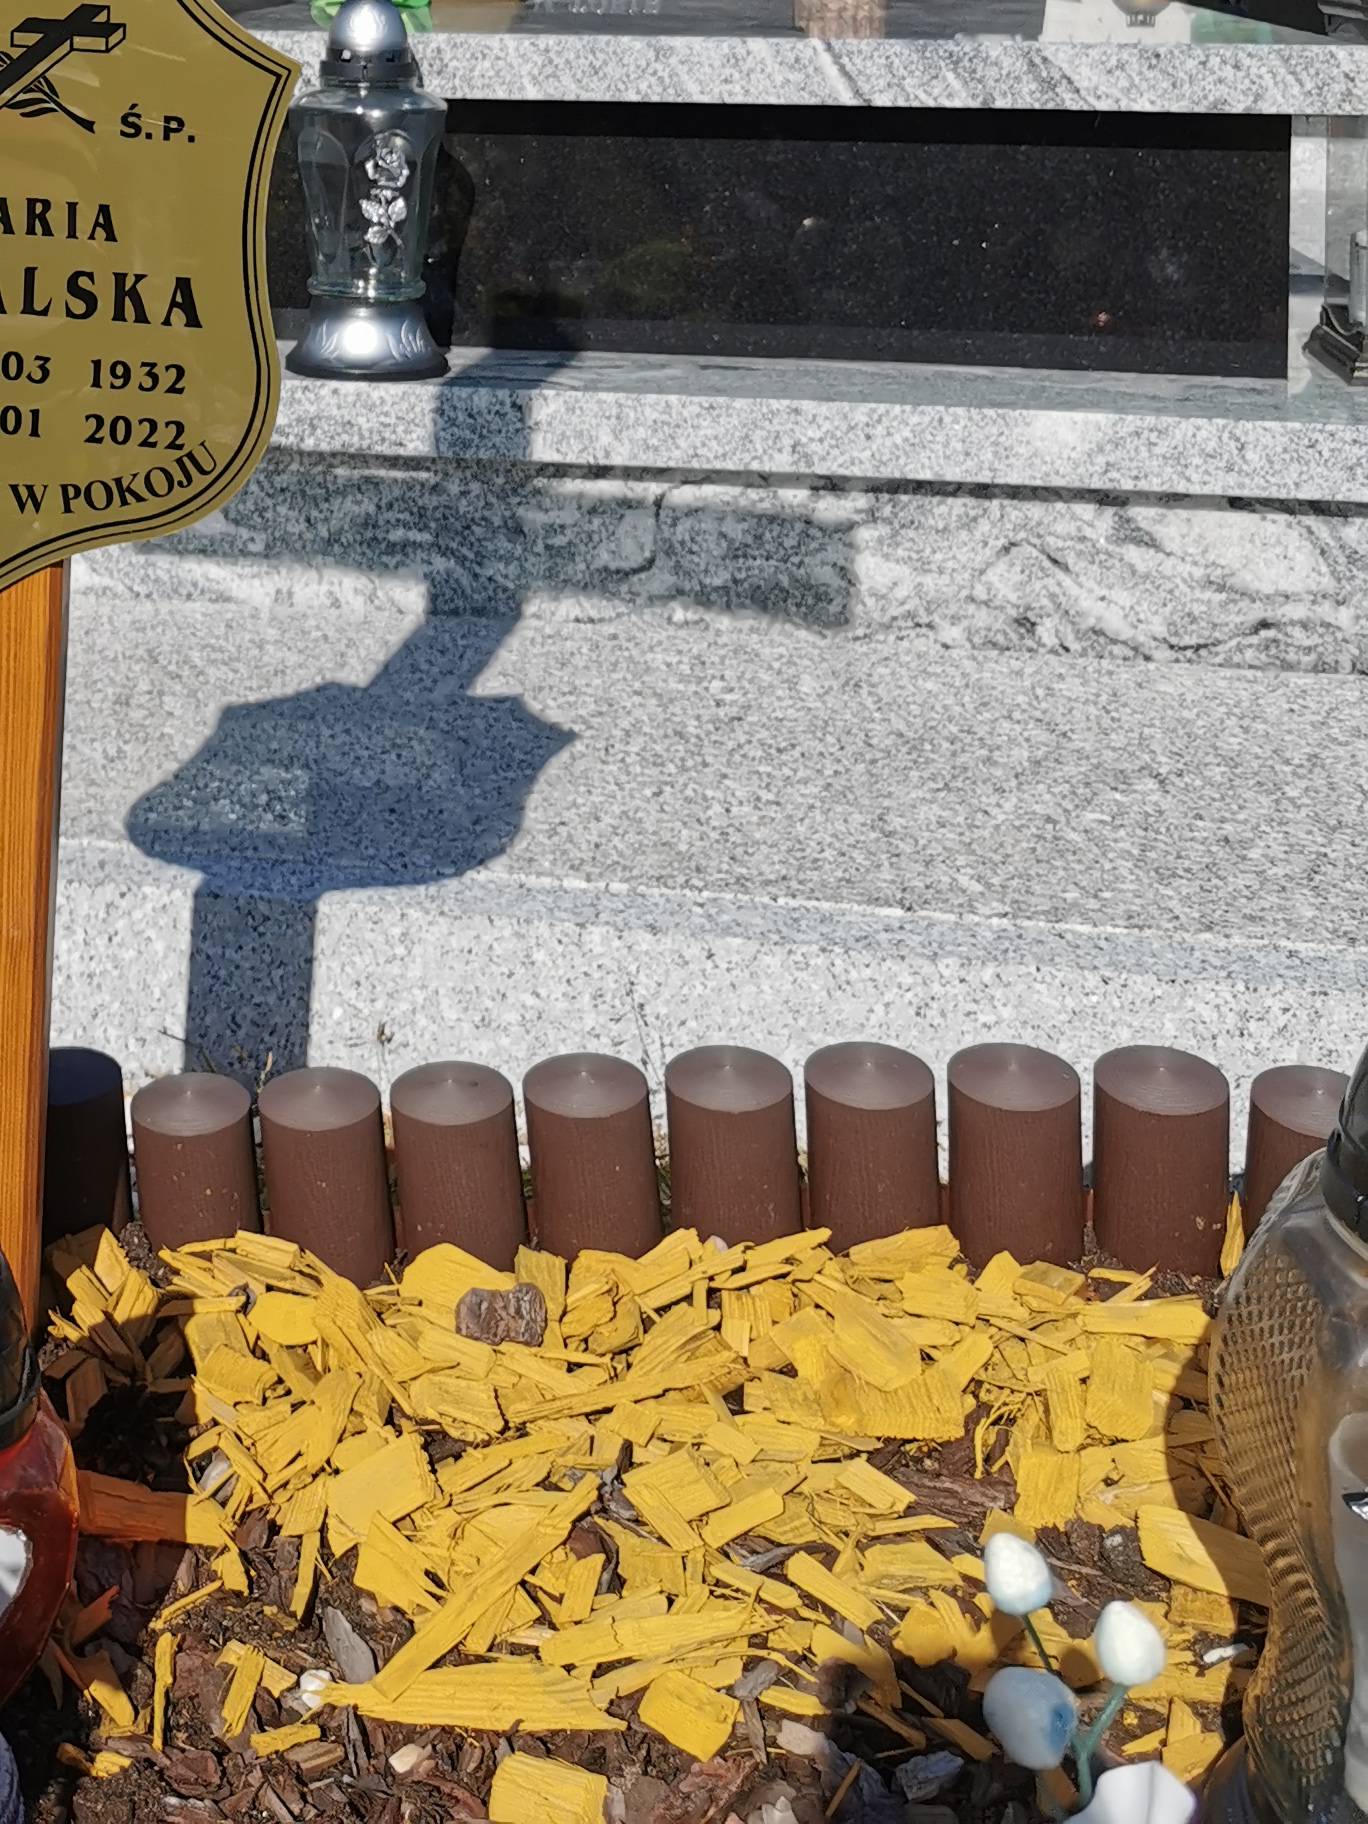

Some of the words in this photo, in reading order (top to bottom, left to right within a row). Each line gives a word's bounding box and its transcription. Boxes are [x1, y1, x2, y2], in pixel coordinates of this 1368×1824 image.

[119, 103, 196, 144] Ś.P.
[1, 350, 52, 385] 03
[89, 358, 186, 395] 1932
[0, 405, 42, 438] 01
[83, 413, 186, 451] 2022
[8, 483, 49, 515] W
[59, 439, 217, 515] POKOJU
